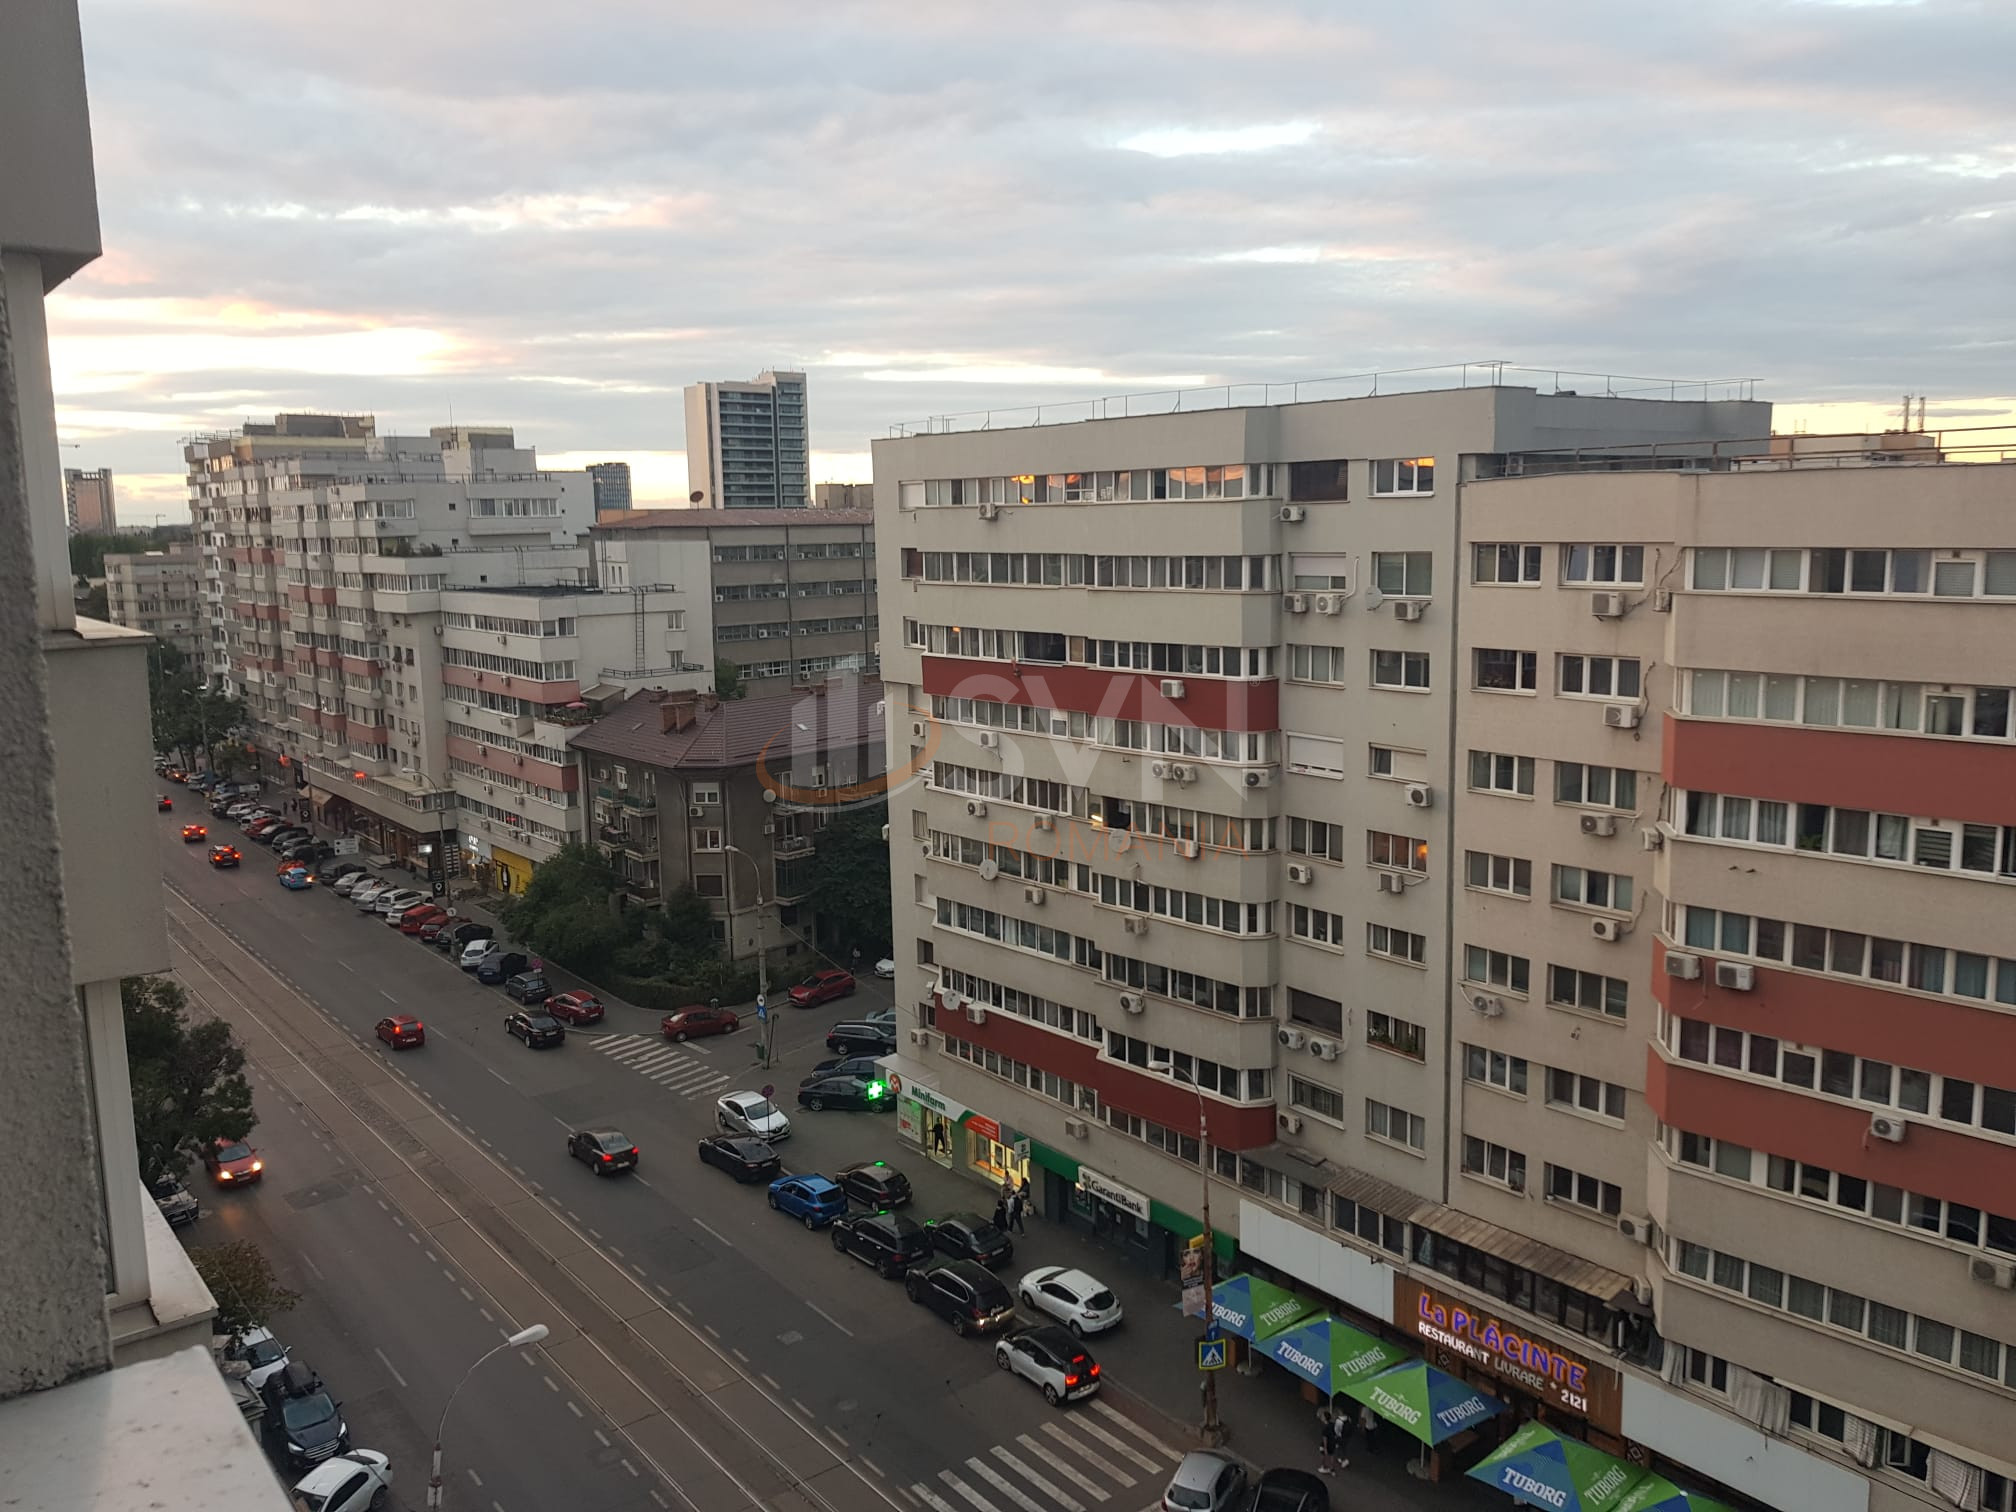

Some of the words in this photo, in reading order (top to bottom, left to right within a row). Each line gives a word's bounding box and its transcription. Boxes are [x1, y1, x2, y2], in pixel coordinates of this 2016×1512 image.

[911, 1085, 946, 1111] Minifarm
[1260, 1299, 1301, 1326] TUBORG
[1419, 1293, 1447, 1327] La
[1276, 1341, 1324, 1377] TUBORG
[1418, 1321, 1490, 1365] RESTAURANT
[1338, 1346, 1386, 1377] TUBORG
[1494, 1356, 1544, 1391] LIVRARE
[1369, 1386, 1422, 1425] TUBORG
[1436, 1396, 1486, 1427] TUBORG
[1502, 1467, 1567, 1508] TUBORG
[1584, 1464, 1627, 1505] TUBORG
